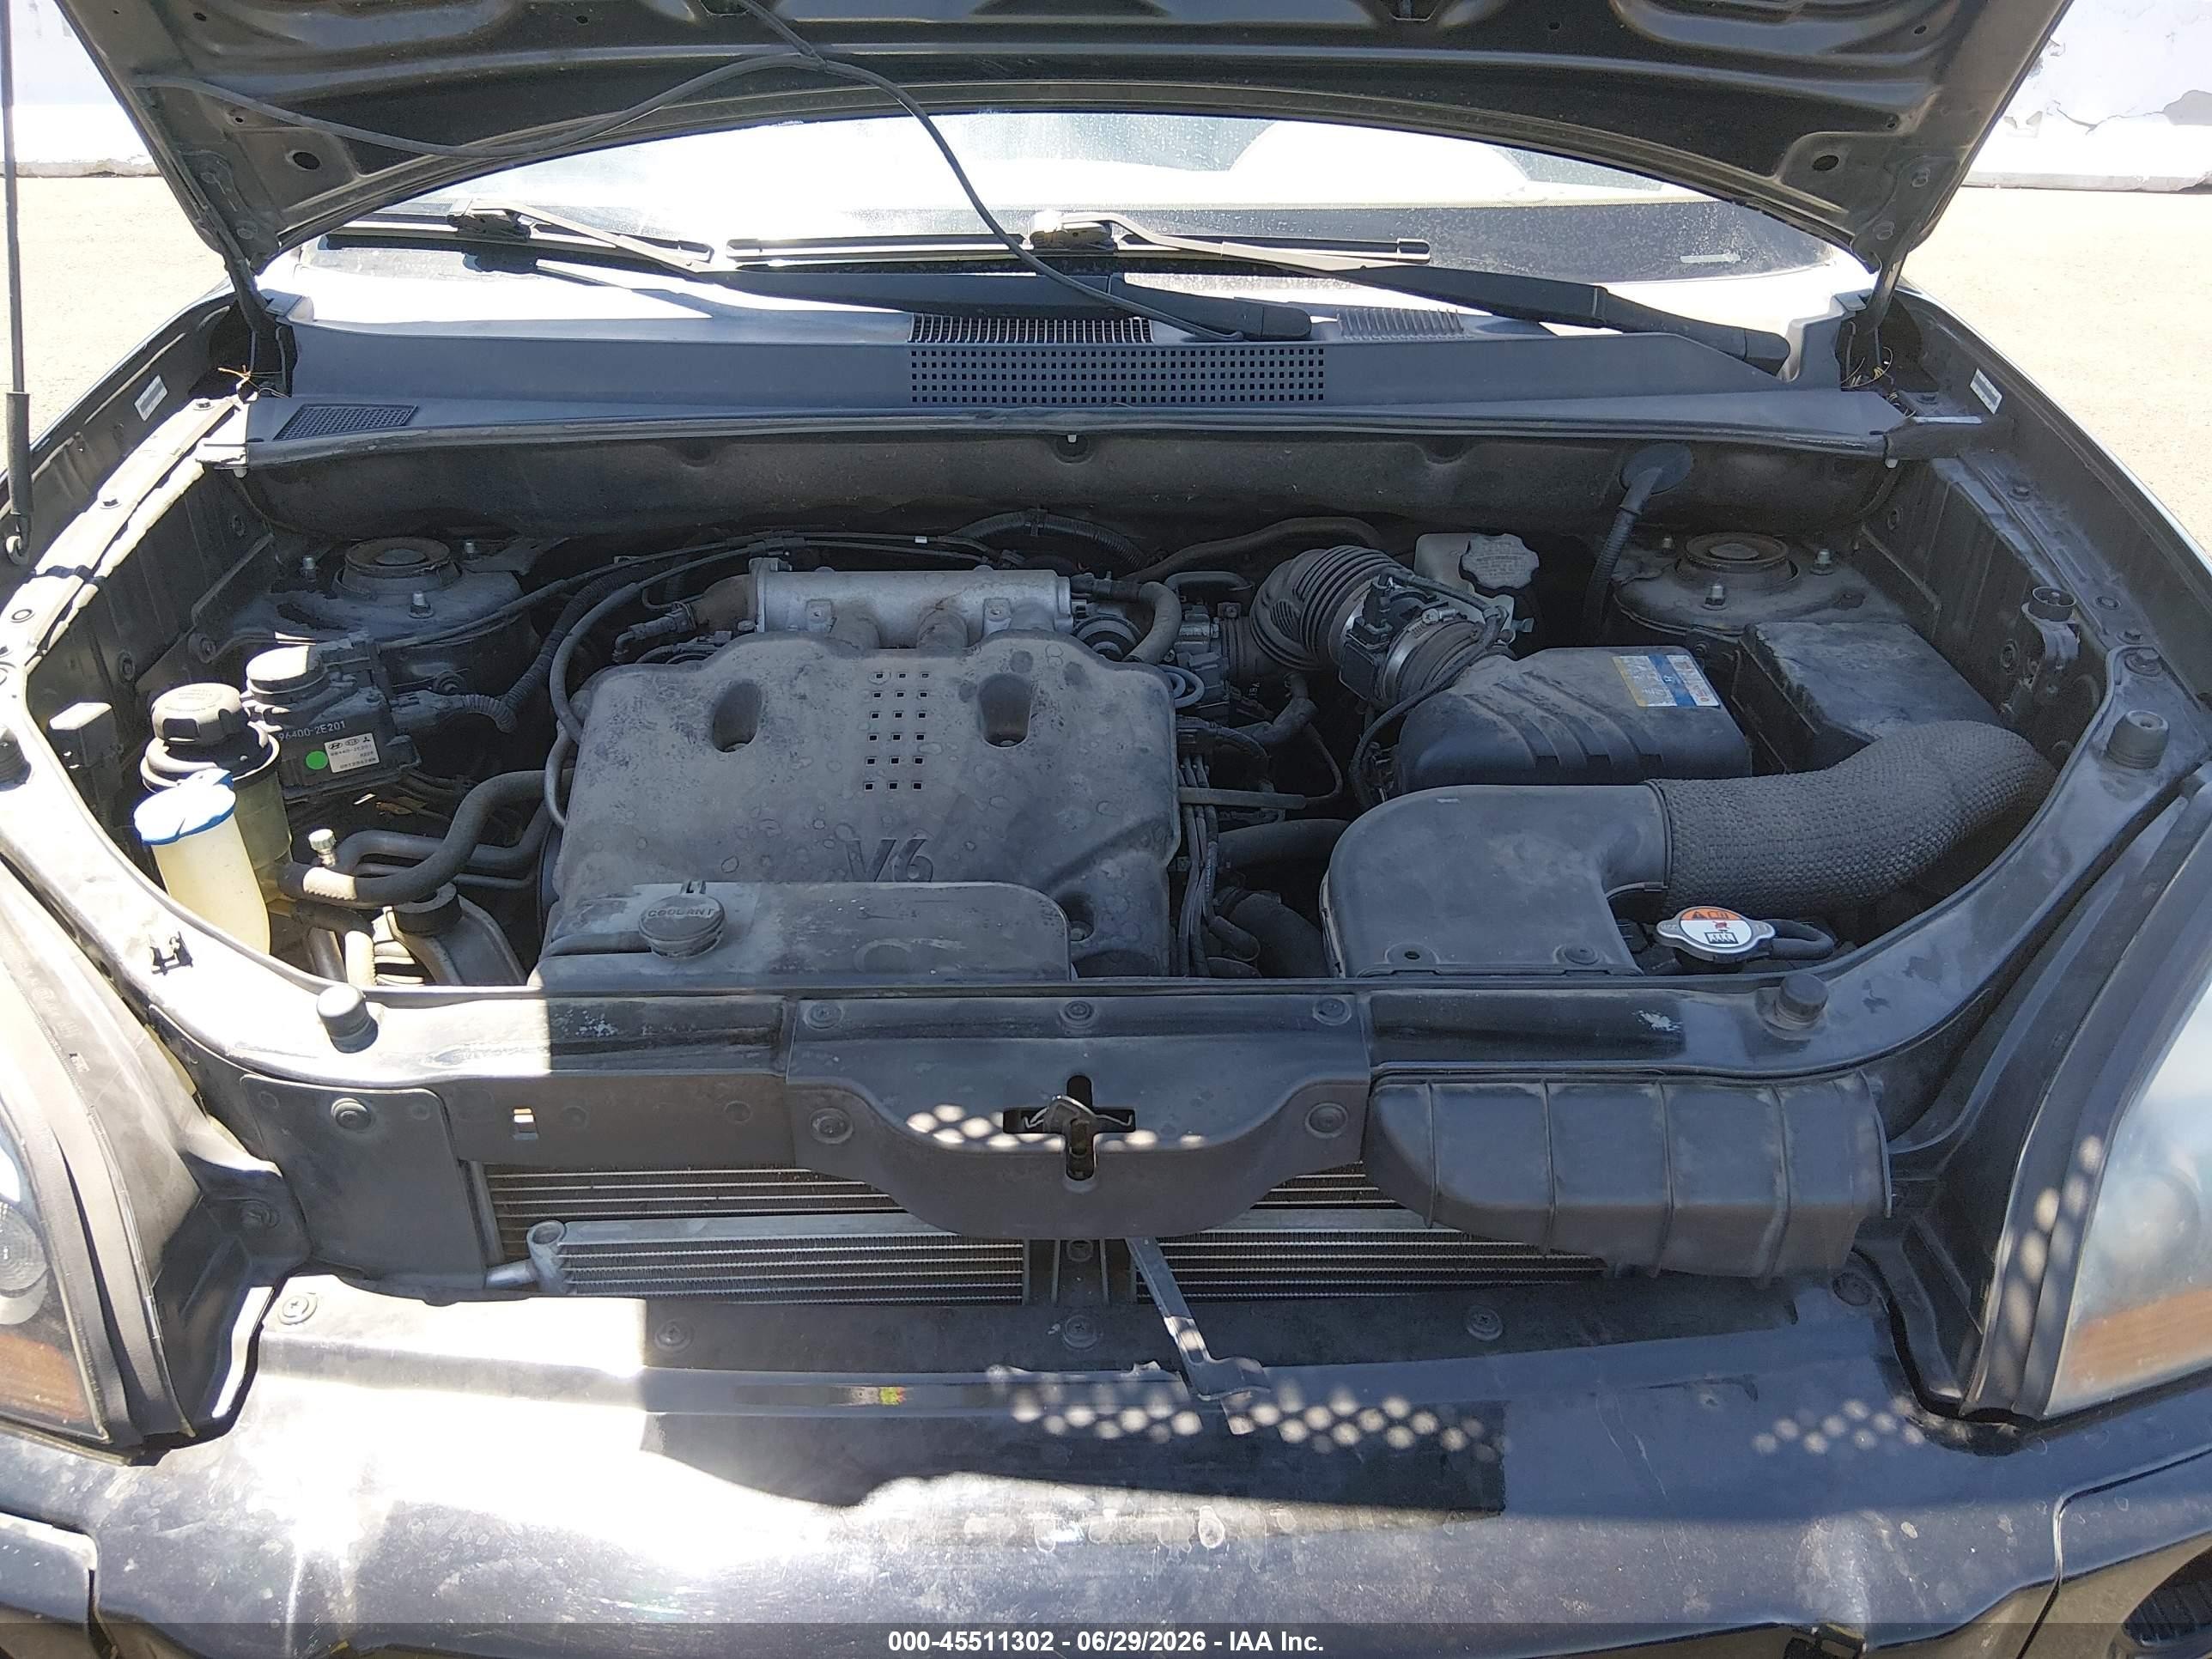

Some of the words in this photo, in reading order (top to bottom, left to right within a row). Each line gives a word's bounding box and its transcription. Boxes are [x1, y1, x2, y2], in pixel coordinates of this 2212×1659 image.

[277, 720, 346, 741] 96400-2E201
[844, 837, 935, 883] V6
[647, 907, 715, 918] COOLANT
